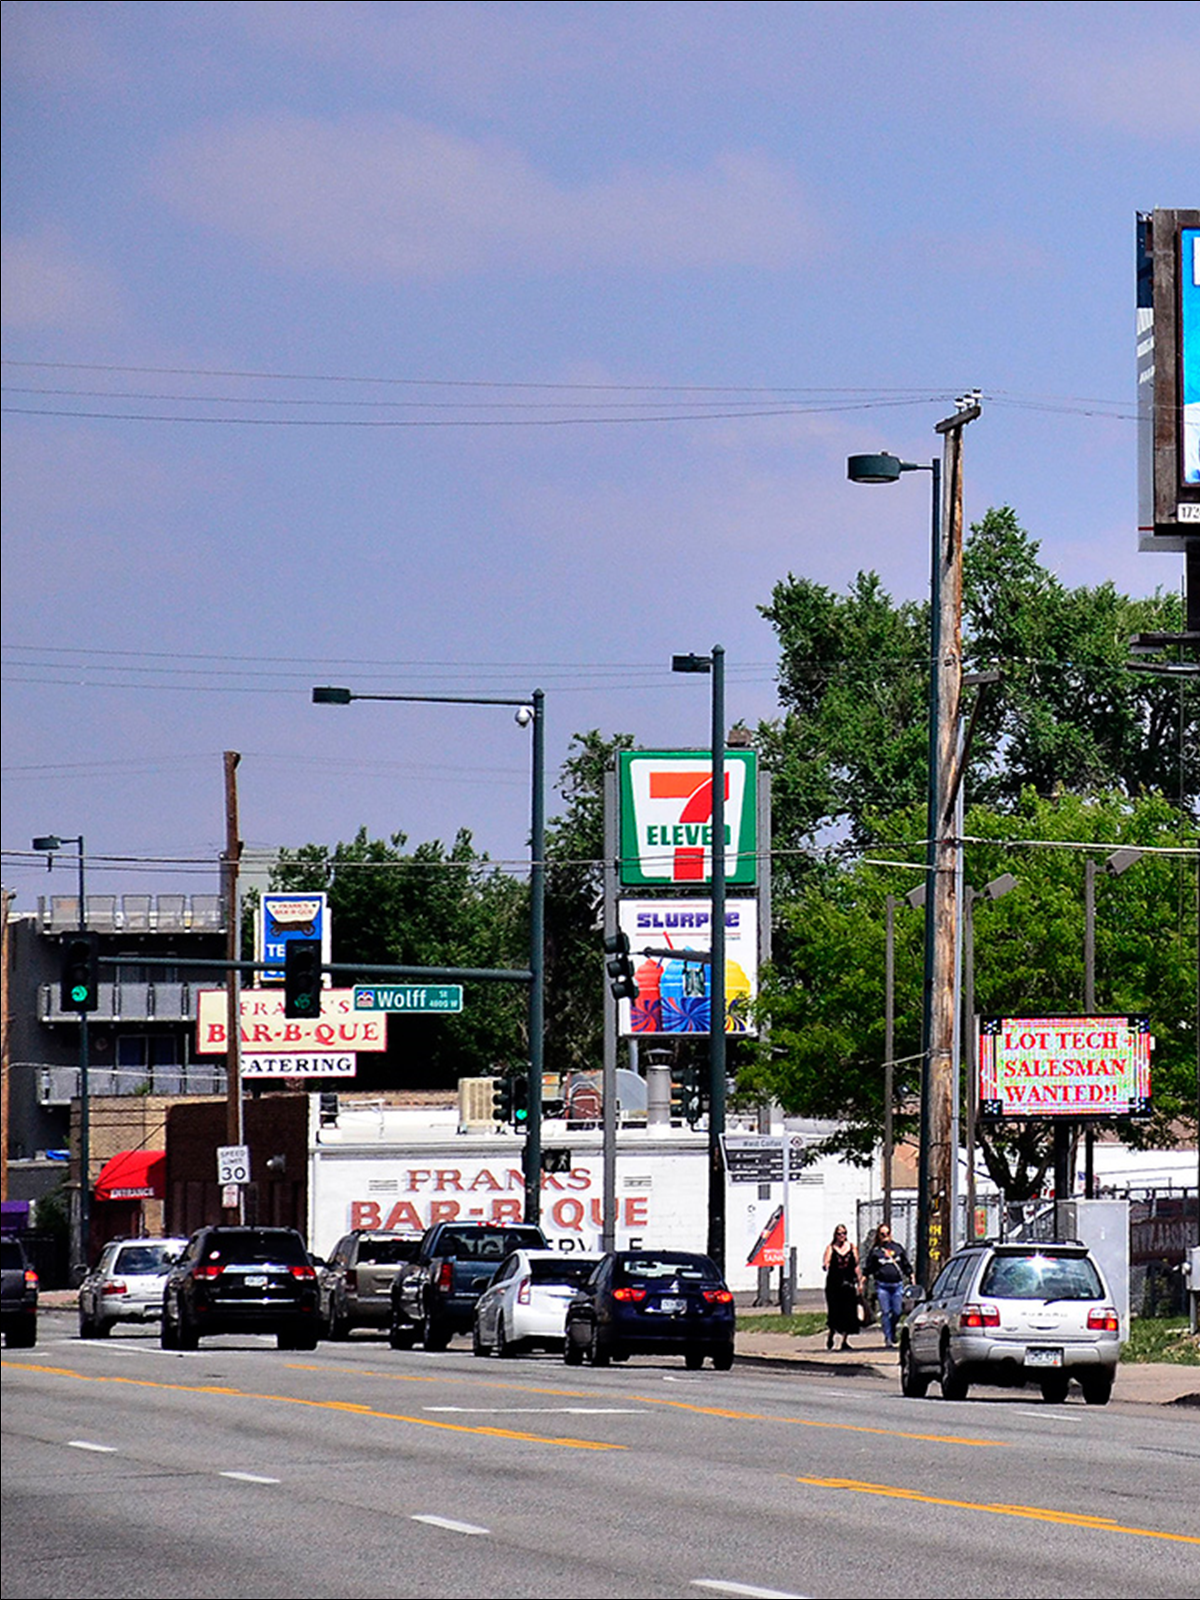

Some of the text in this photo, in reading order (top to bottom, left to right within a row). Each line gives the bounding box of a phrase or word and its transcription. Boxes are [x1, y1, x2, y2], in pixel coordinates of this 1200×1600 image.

[637, 912, 740, 928] SLURPE
[240, 1000, 350, 1014] FRA'S
[377, 990, 427, 1008] Wolff
[207, 1022, 380, 1046] BAR-B-QUE
[1004, 1032, 1050, 1050] LOT
[1056, 1032, 1118, 1050] TECH
[1004, 1059, 1127, 1077] SALESMAN
[1004, 1085, 1118, 1102] WANTED!!
[220, 1150, 246, 1158] SPEED
[222, 1166, 246, 1181] 30
[110, 1187, 155, 1198] ENTRANCE
[350, 1196, 648, 1232] BAR-BQUE
